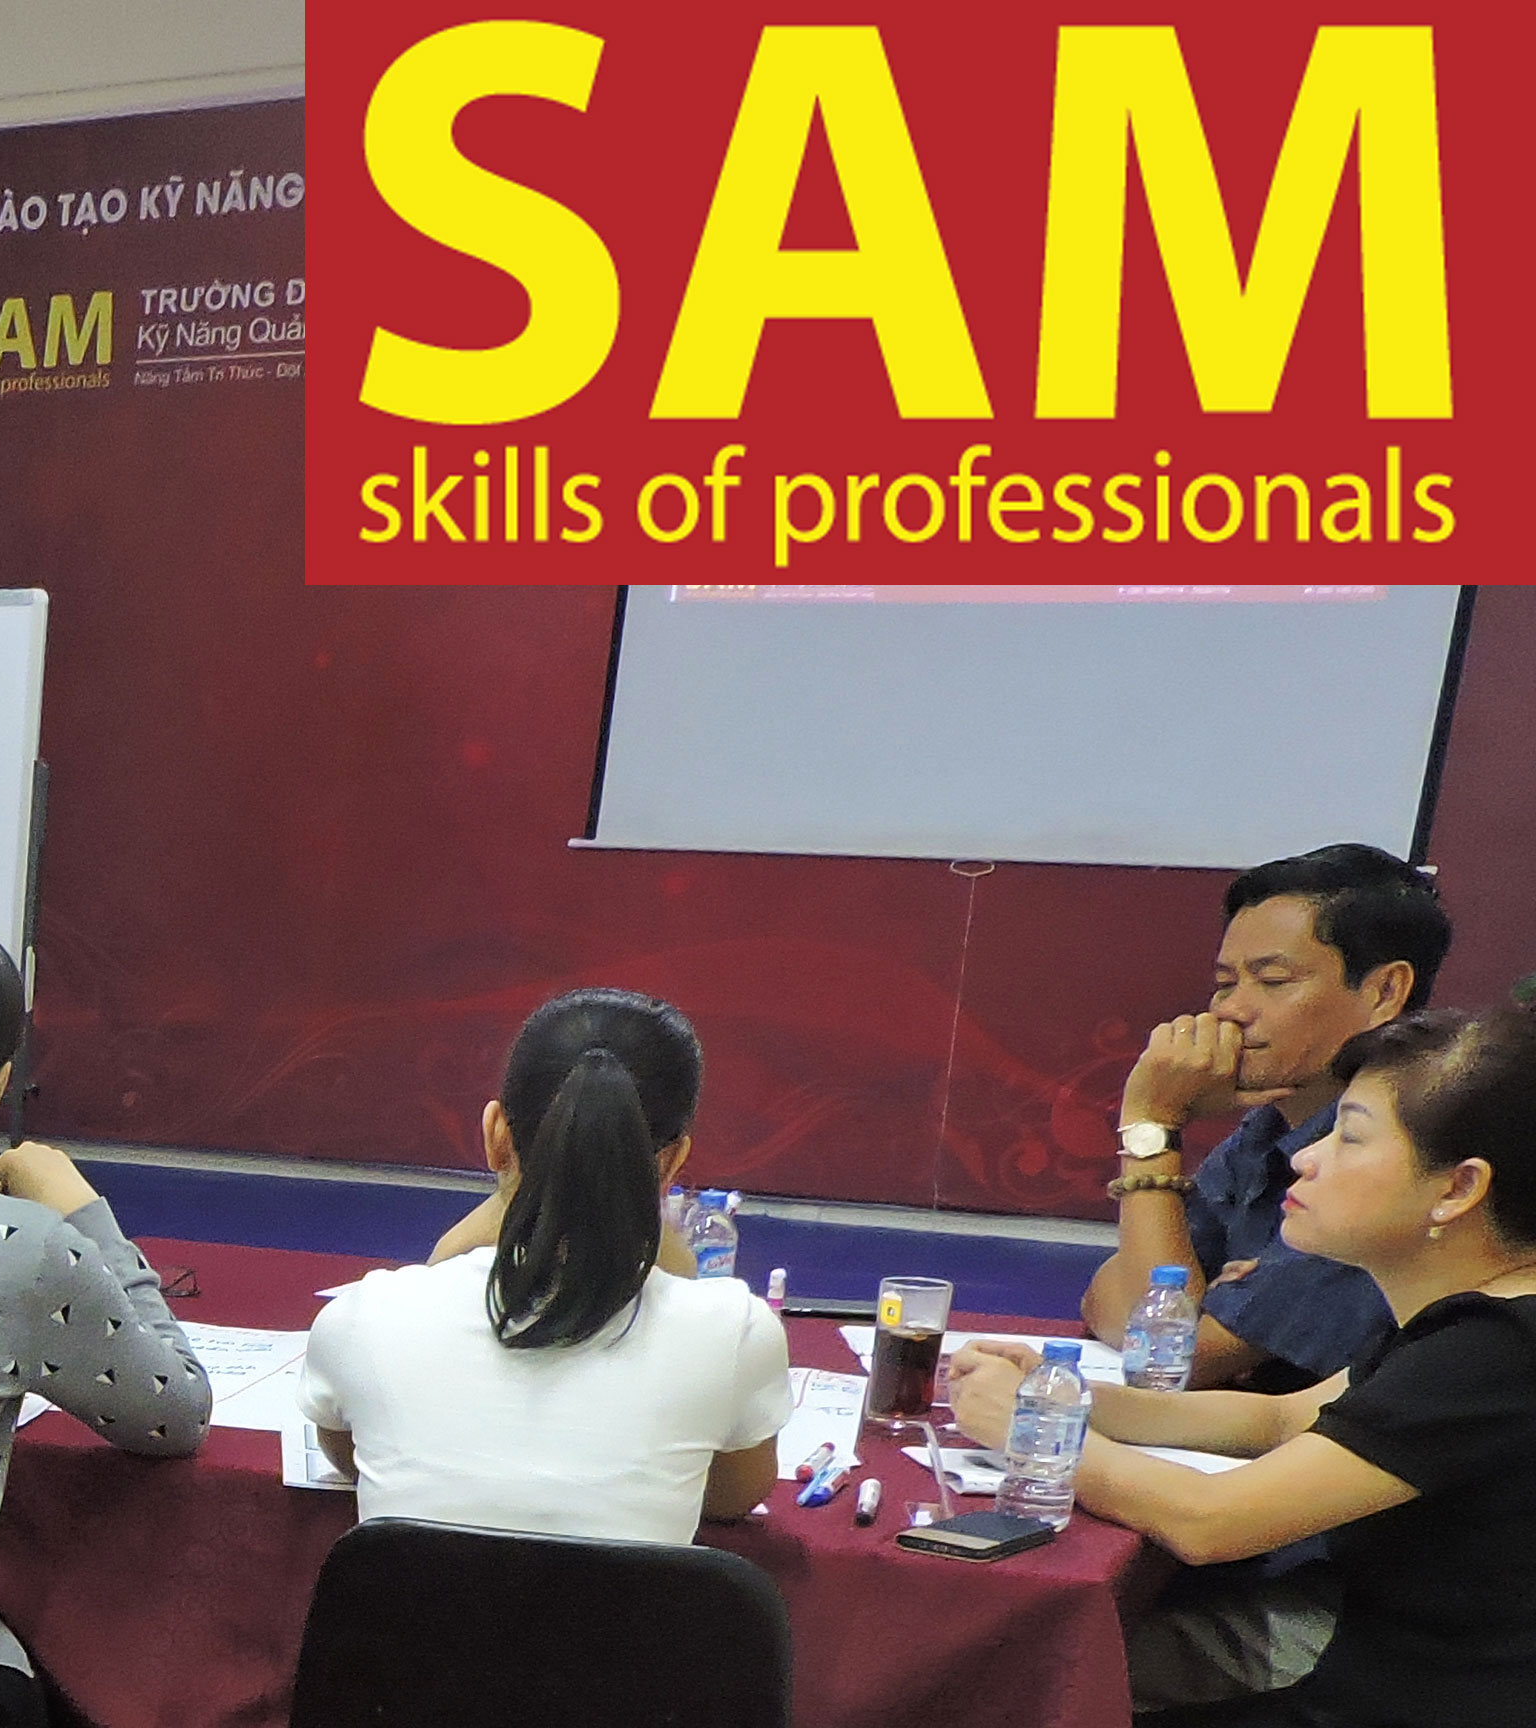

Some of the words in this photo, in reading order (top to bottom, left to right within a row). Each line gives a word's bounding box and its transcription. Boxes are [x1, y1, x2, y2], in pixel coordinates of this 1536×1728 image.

[57, 188, 128, 236] TẠO
[141, 279, 276, 315] TRƯỜNG
[137, 322, 170, 356] Kỹ
[175, 321, 242, 351] Năng
[249, 313, 305, 344] Quả
[0, 369, 111, 396] professionals
